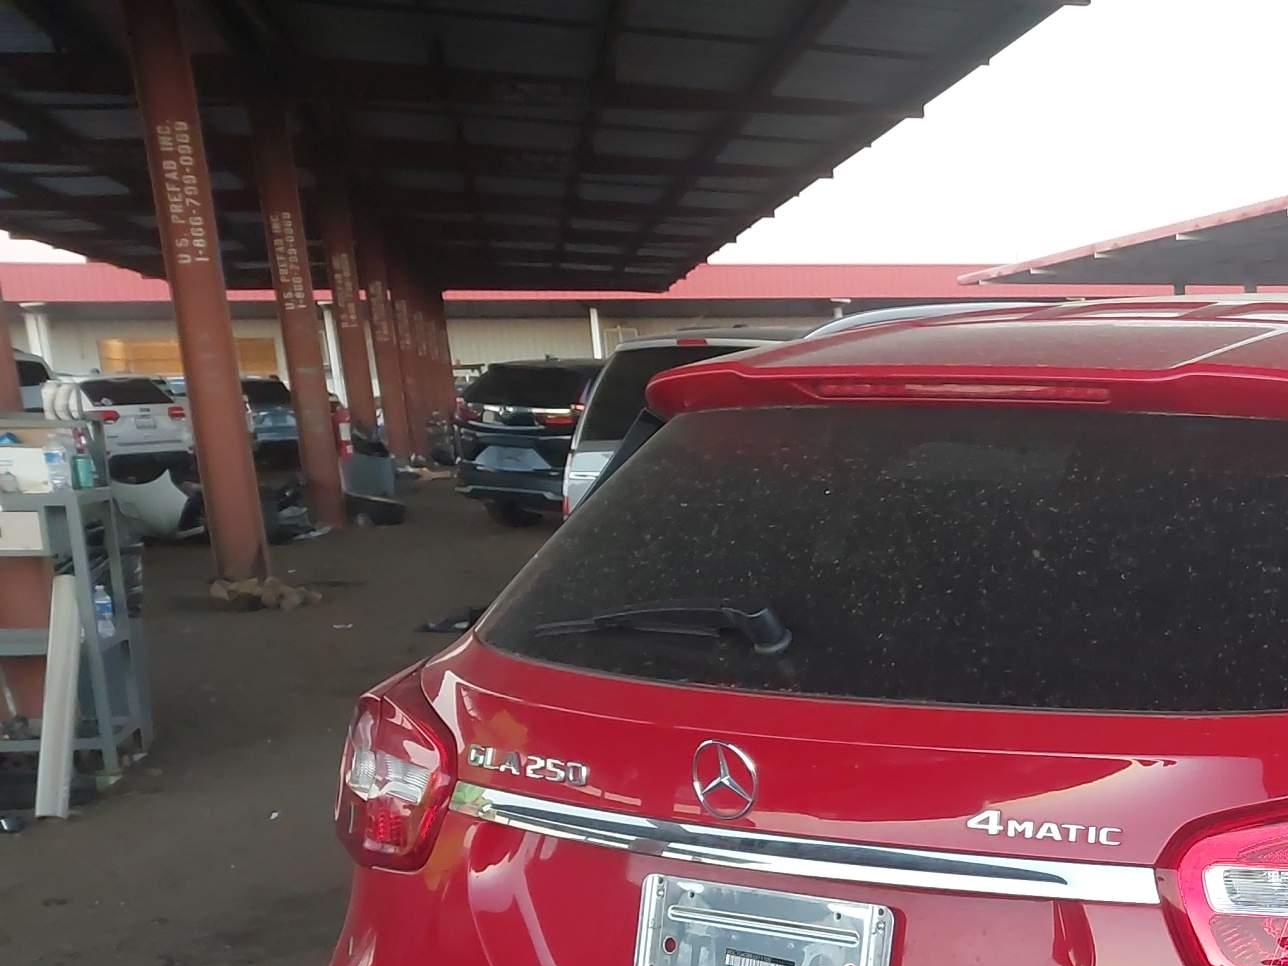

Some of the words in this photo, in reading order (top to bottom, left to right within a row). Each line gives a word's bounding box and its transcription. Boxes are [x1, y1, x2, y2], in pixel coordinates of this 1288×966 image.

[162, 160, 186, 224] PREFAB
[467, 743, 521, 776] GLA
[525, 754, 590, 786] 250
[966, 809, 1123, 846] 4MATIC
